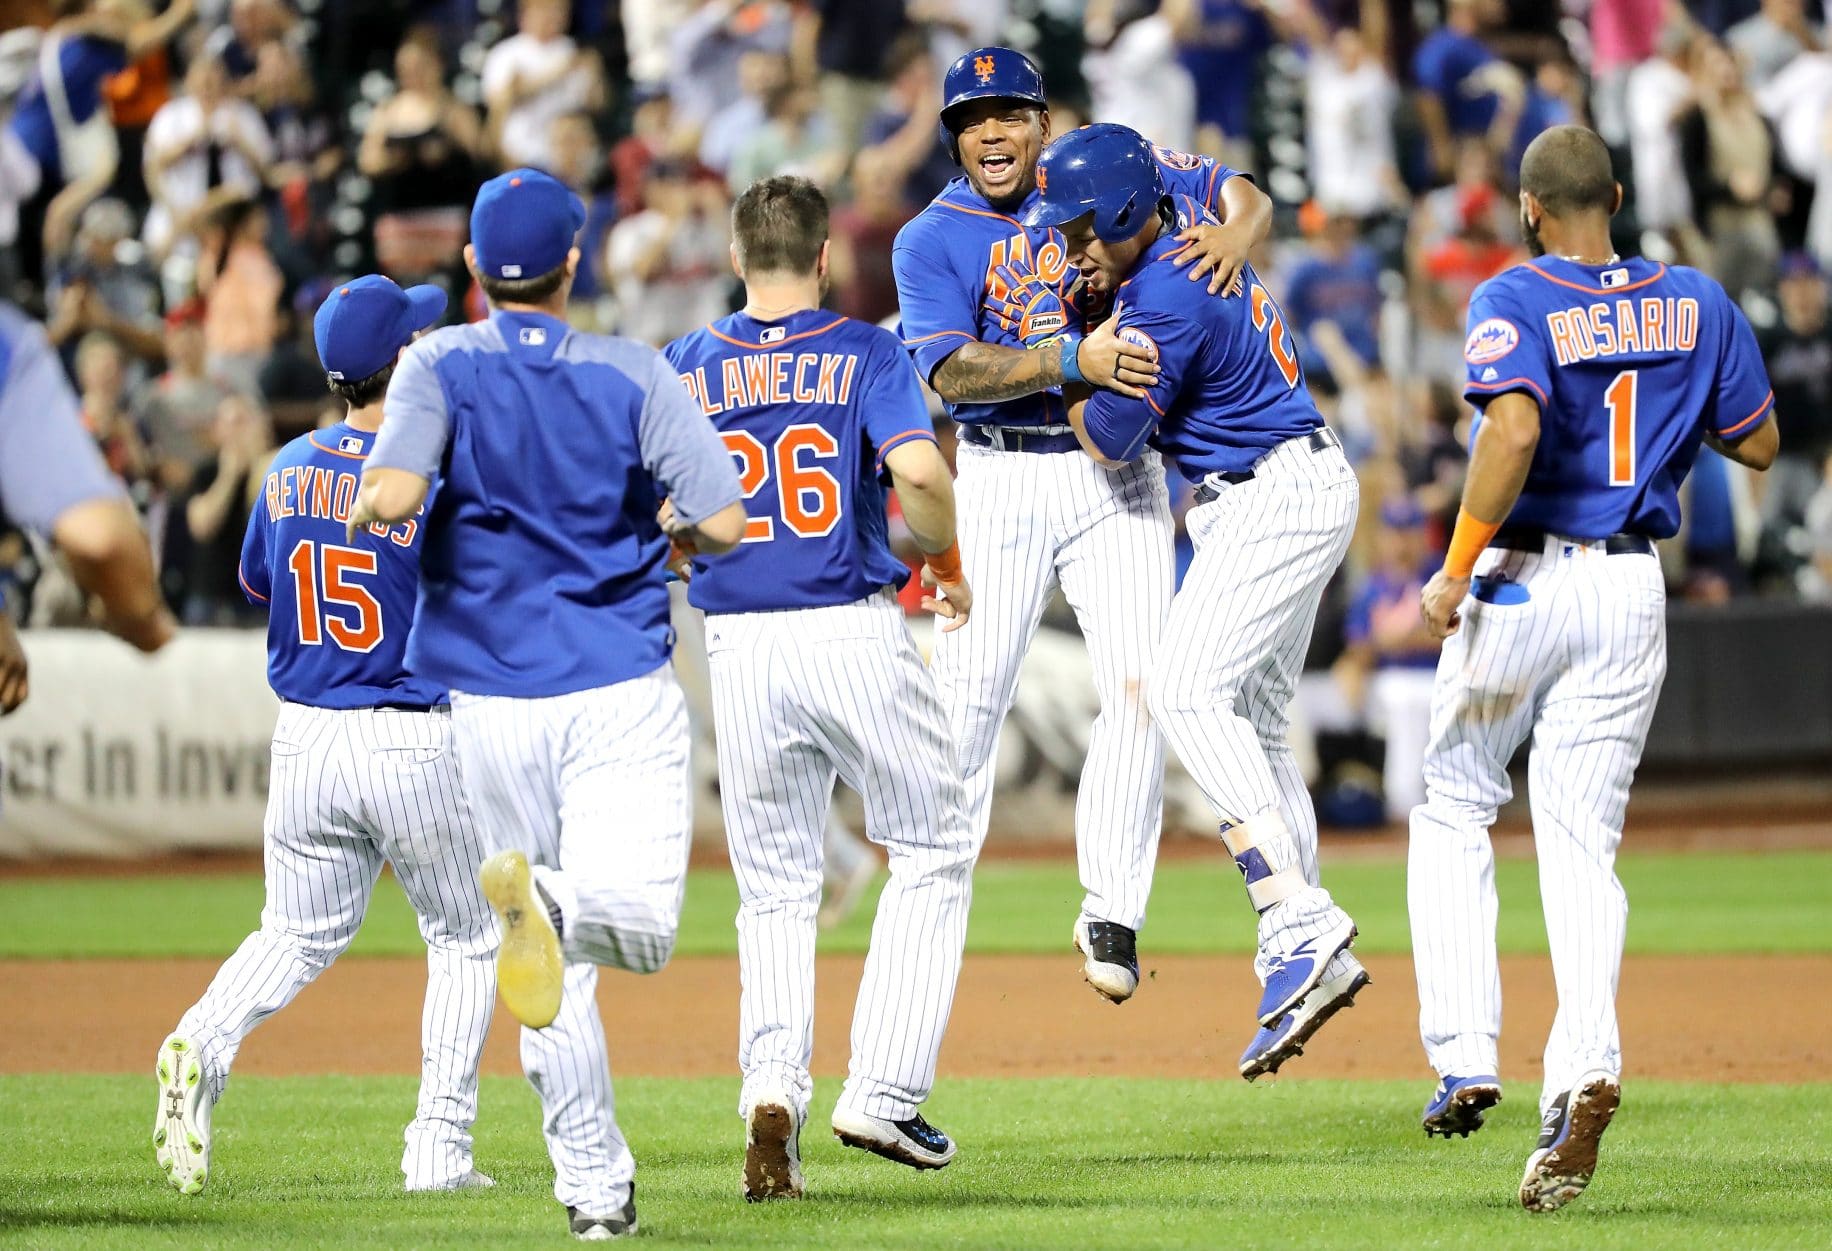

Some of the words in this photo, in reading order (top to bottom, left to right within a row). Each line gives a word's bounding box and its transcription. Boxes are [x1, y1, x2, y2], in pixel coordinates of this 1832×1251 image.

[1547, 297, 1698, 366] ROSARIO
[719, 423, 842, 543] 26
[1604, 370, 1638, 487] 1
[266, 466, 424, 547] REYNOS
[288, 539, 384, 653] 15
